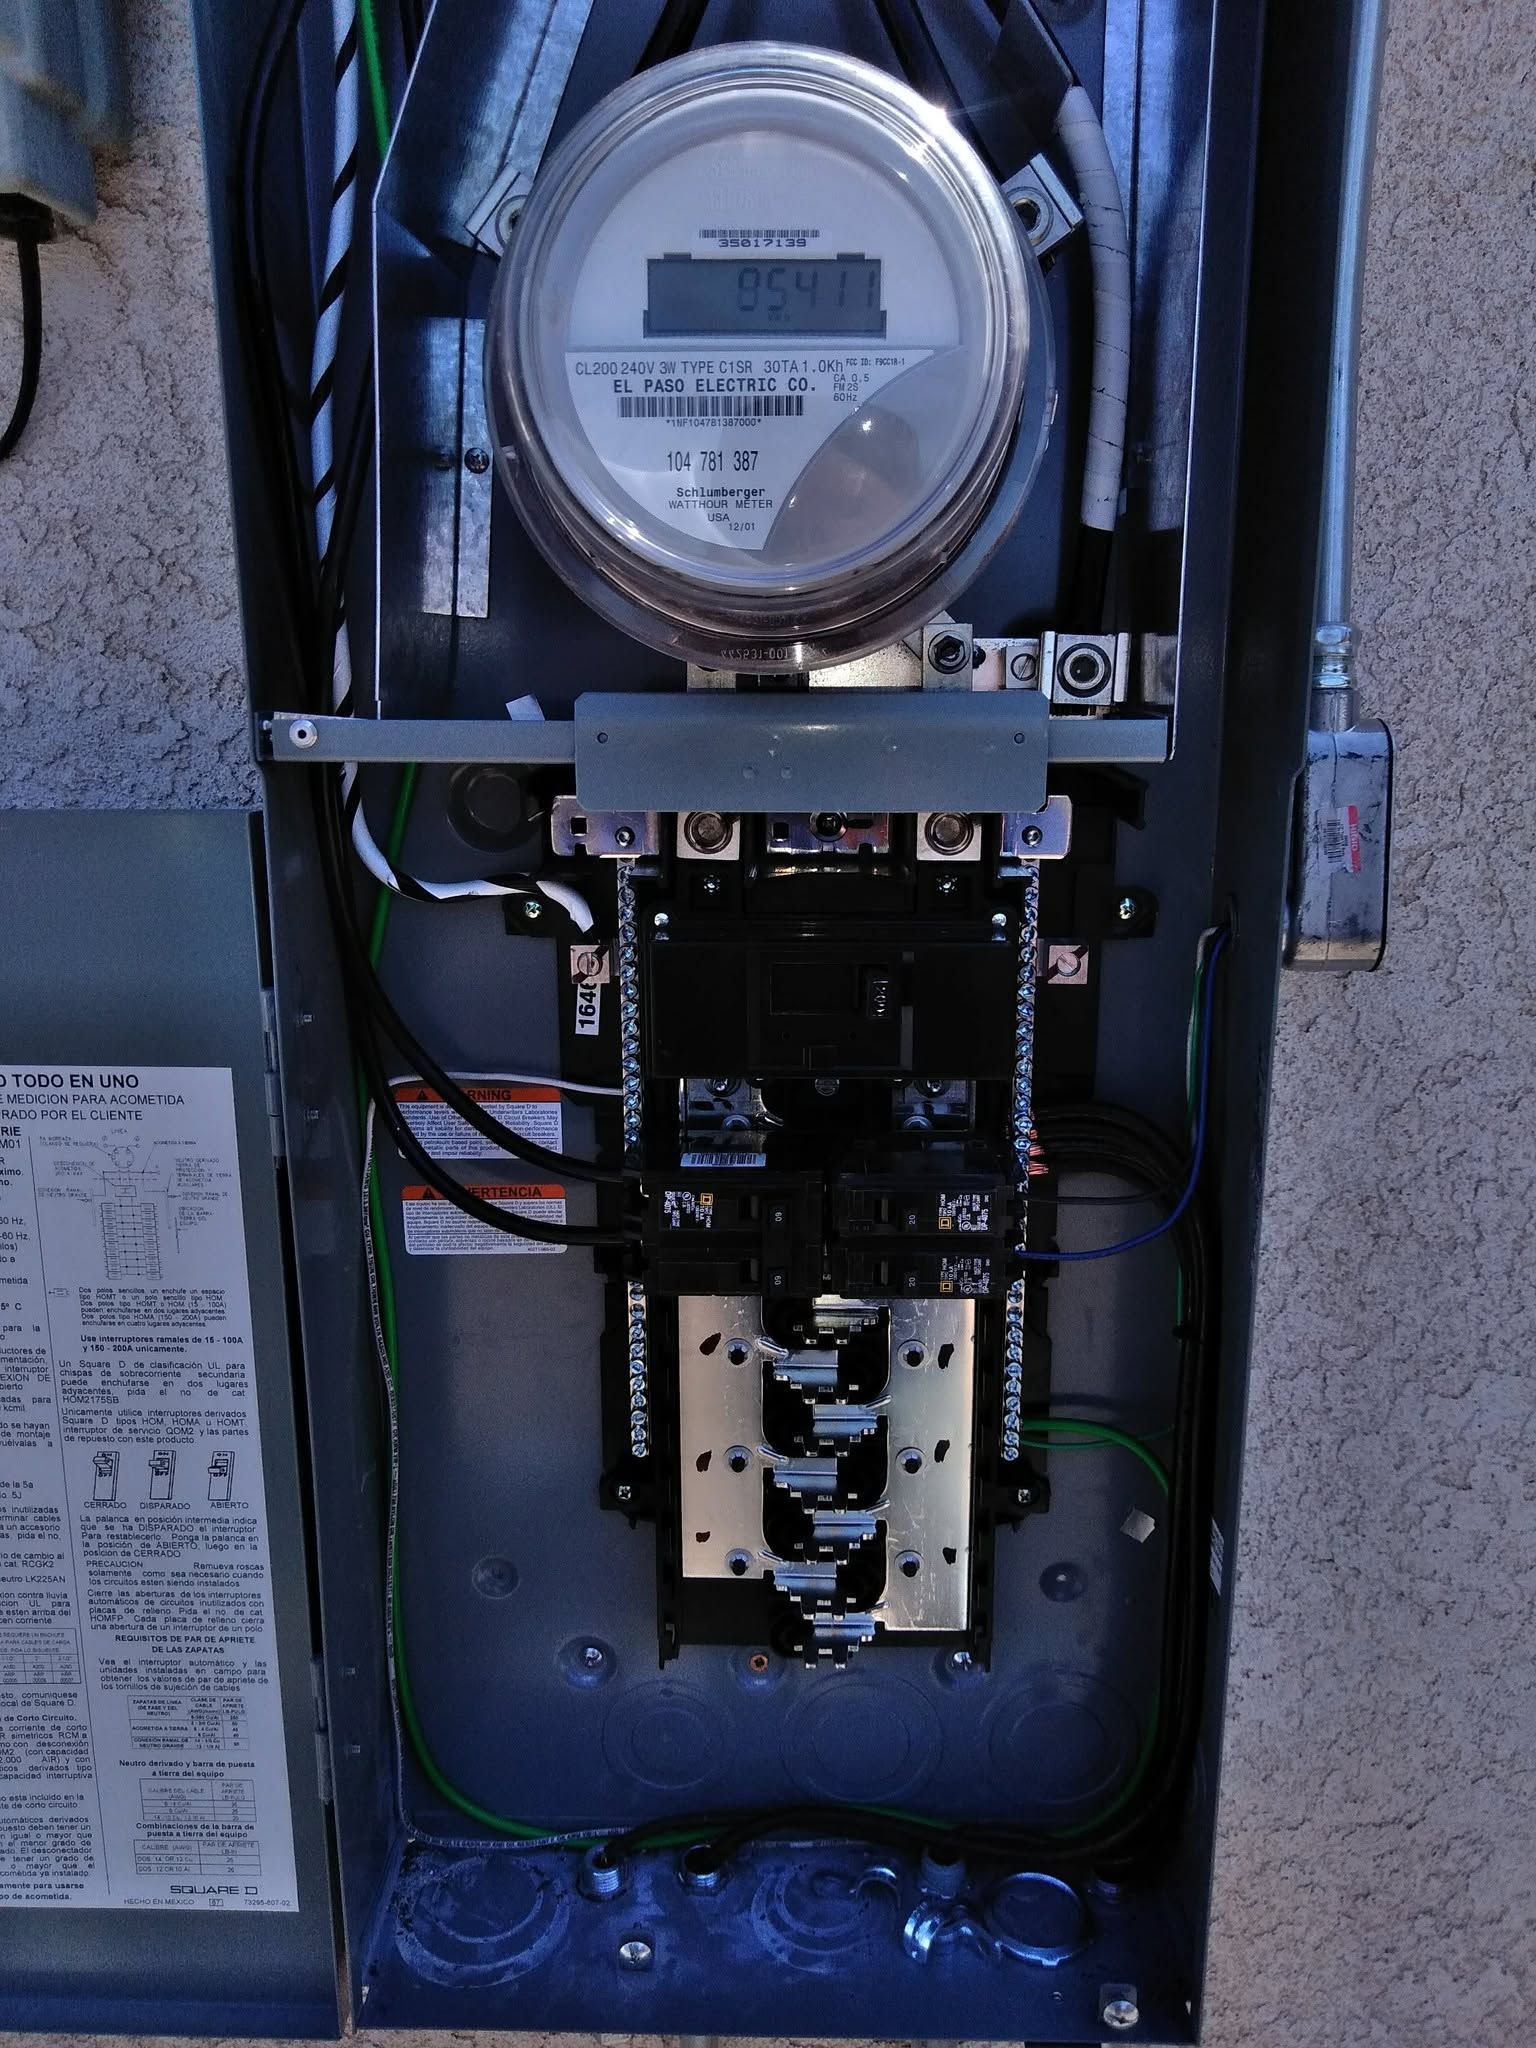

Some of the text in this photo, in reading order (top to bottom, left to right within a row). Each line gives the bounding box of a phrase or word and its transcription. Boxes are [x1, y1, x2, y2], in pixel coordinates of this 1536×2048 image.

[719, 239, 807, 247] 35017139
[738, 267, 876, 312] 85411
[576, 359, 843, 375] CL200 240V 3W TYPE C1SR 30TA 1.0Kh
[833, 373, 869, 382] CA 0.5
[614, 377, 815, 393] EL PASO ELECTRIC CO.
[833, 383, 858, 391] FM 2S
[667, 450, 758, 471] 104 781 387
[676, 487, 765, 499] Schlumberger
[669, 500, 773, 509] WATTHOUR METER
[707, 513, 730, 521] USA
[729, 523, 755, 531] 12/01
[12, 1074, 138, 1088] TODO EN UNO
[7, 1094, 184, 1105] MEDICION PARA ACOMETIDA
[41, 1110, 67, 1120] POR
[71, 1110, 86, 1120] EL
[90, 1110, 142, 1120] CLIENTE
[468, 1187, 542, 1198] ERTENCIA
[775, 1212, 782, 1222] 60
[909, 1215, 916, 1224] 20
[774, 1276, 782, 1285] 60
[909, 1277, 916, 1287] 20
[99, 1336, 153, 1345] interruptores
[79, 1361, 110, 1370] Square
[59, 1370, 92, 1378] chispas
[61, 1379, 88, 1388] puede
[217, 1380, 248, 1389] lugares
[127, 1389, 145, 1397] pida
[148, 1410, 201, 1419] interruptores
[63, 1427, 107, 1435] interruptor
[222, 1428, 248, 1437] partes
[78, 1436, 115, 1444] repuesto
[228, 1761, 254, 1770] puesta
[196, 1771, 224, 1779] equipo
[147, 1831, 173, 1839] puesta
[170, 1886, 257, 1895] SQUARE D
